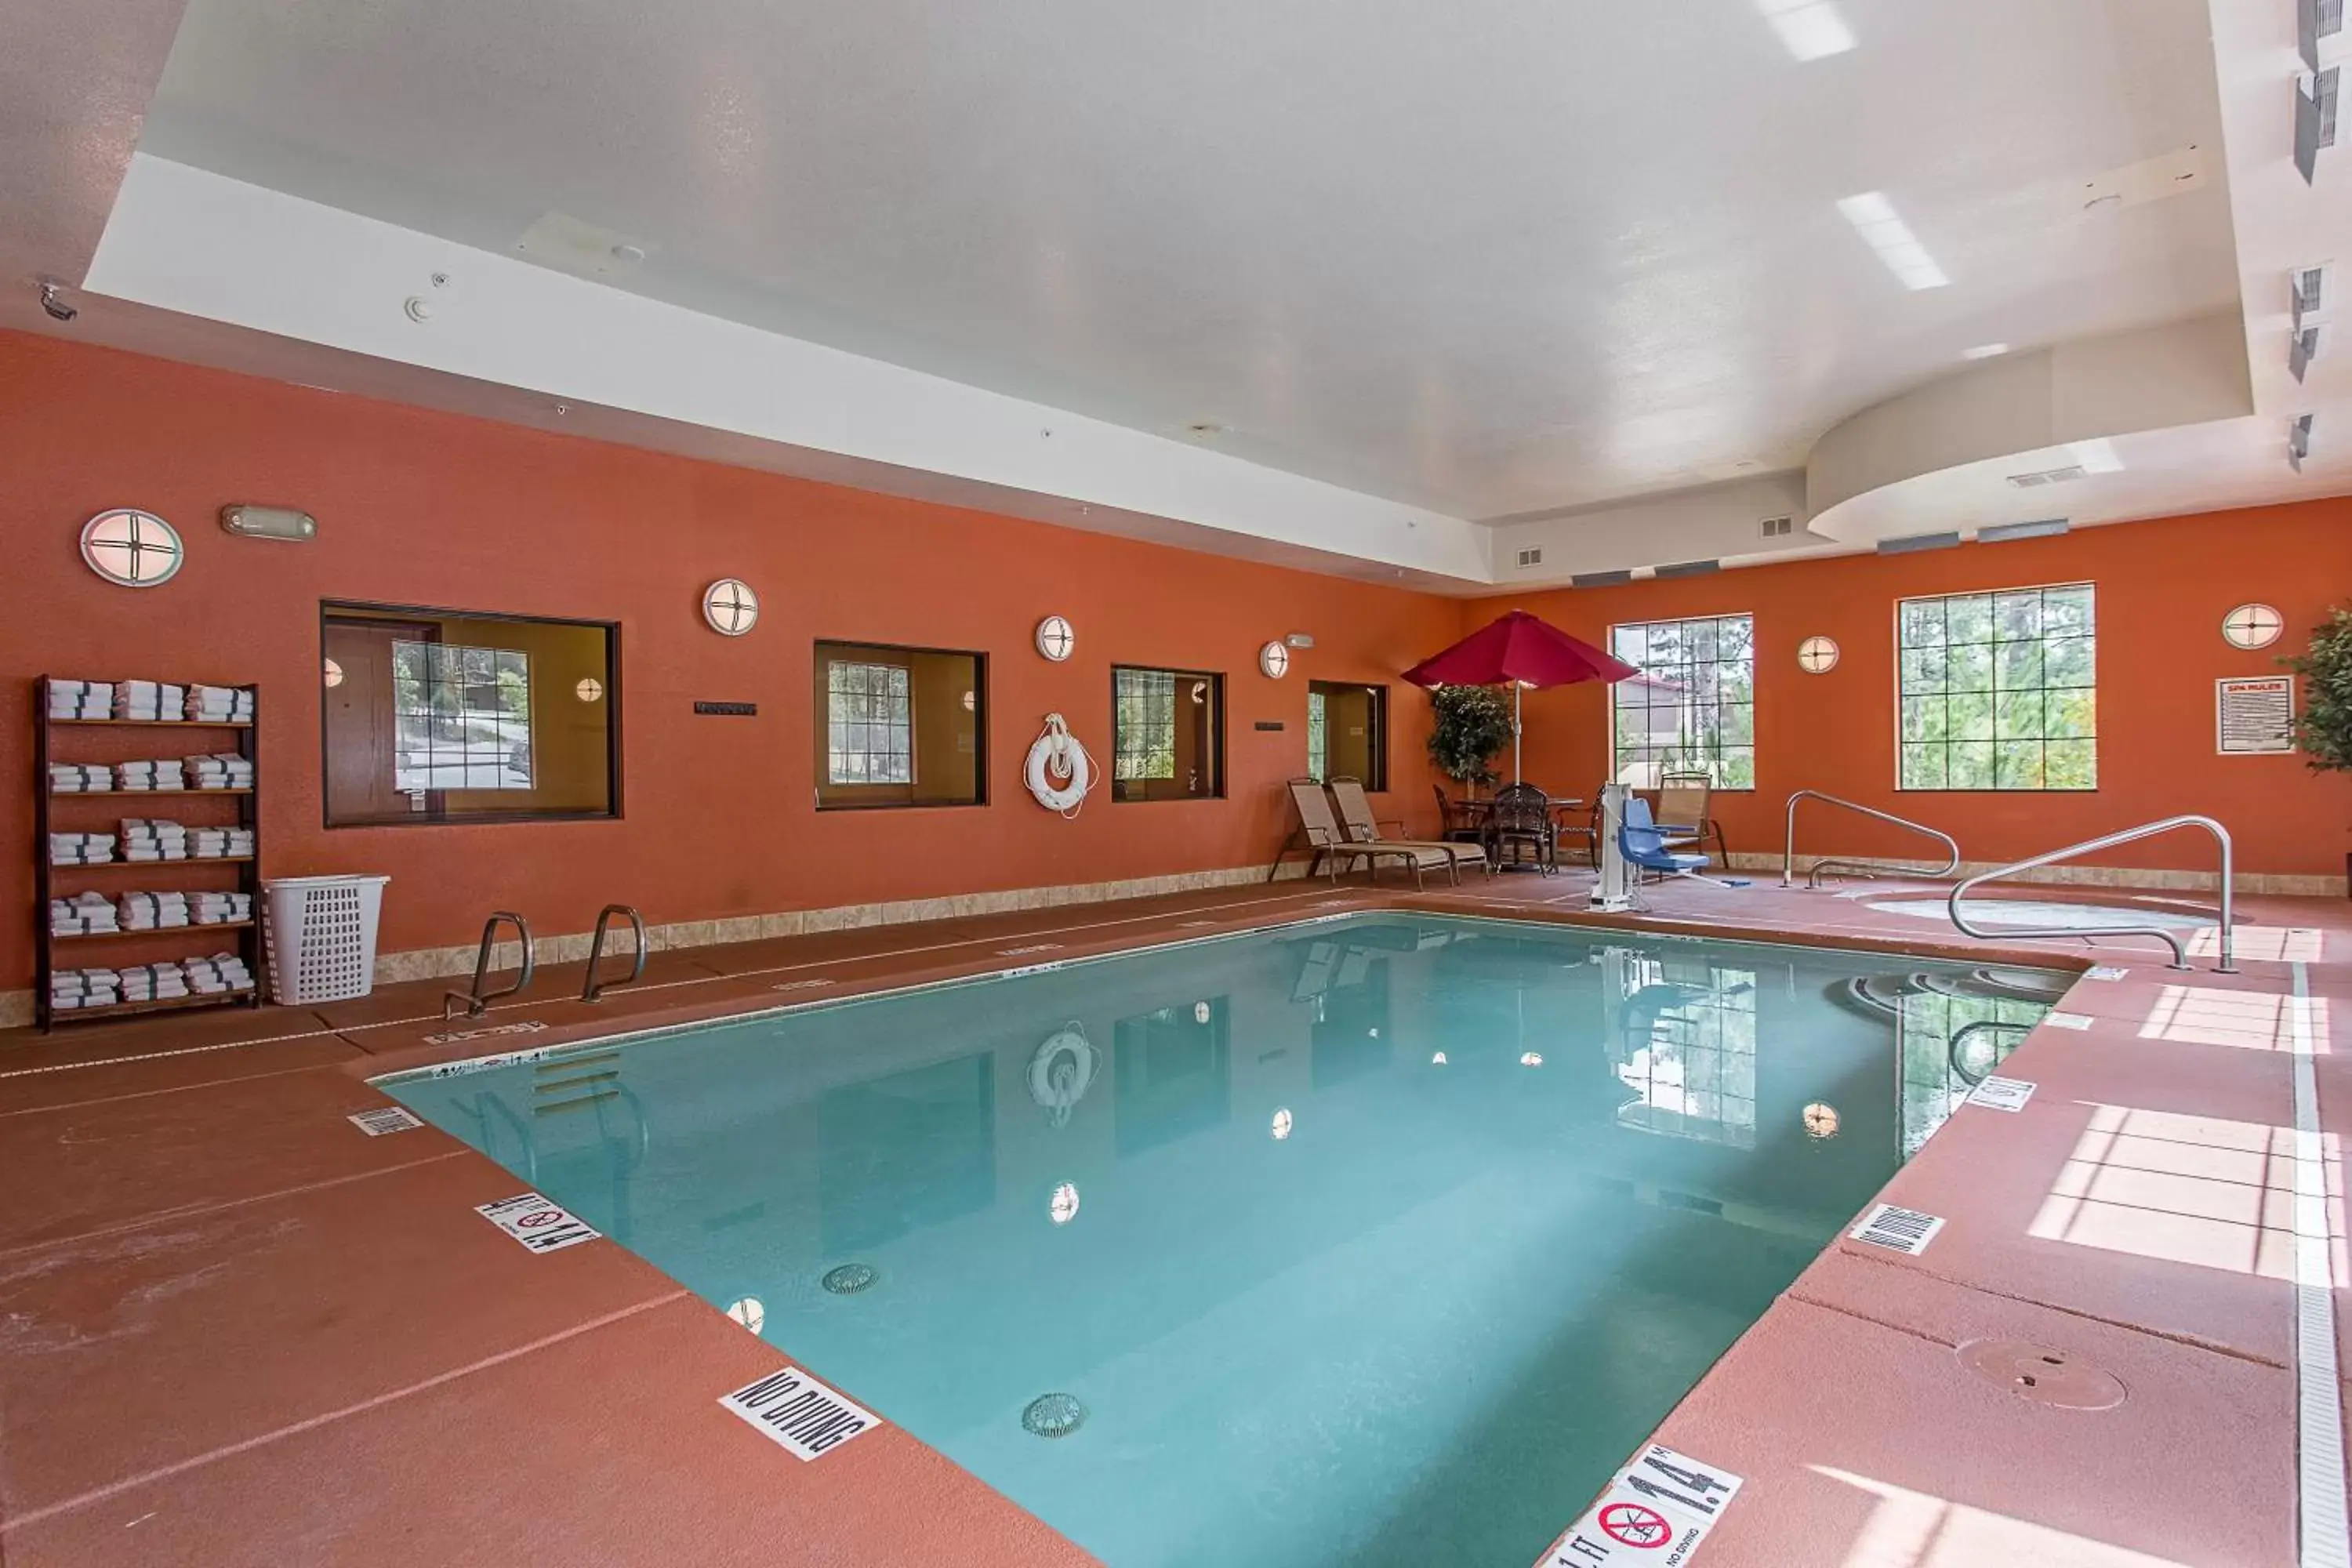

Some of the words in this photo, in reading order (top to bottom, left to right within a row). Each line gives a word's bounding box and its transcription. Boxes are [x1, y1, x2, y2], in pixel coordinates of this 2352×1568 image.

[732, 1372, 800, 1409] NO
[760, 1389, 866, 1453] DIVING
[1627, 1456, 1731, 1515] 1.4
[1570, 1534, 1610, 1562] FT
[1665, 1552, 1682, 1567] NO
[1676, 1528, 1700, 1555] DIVING
